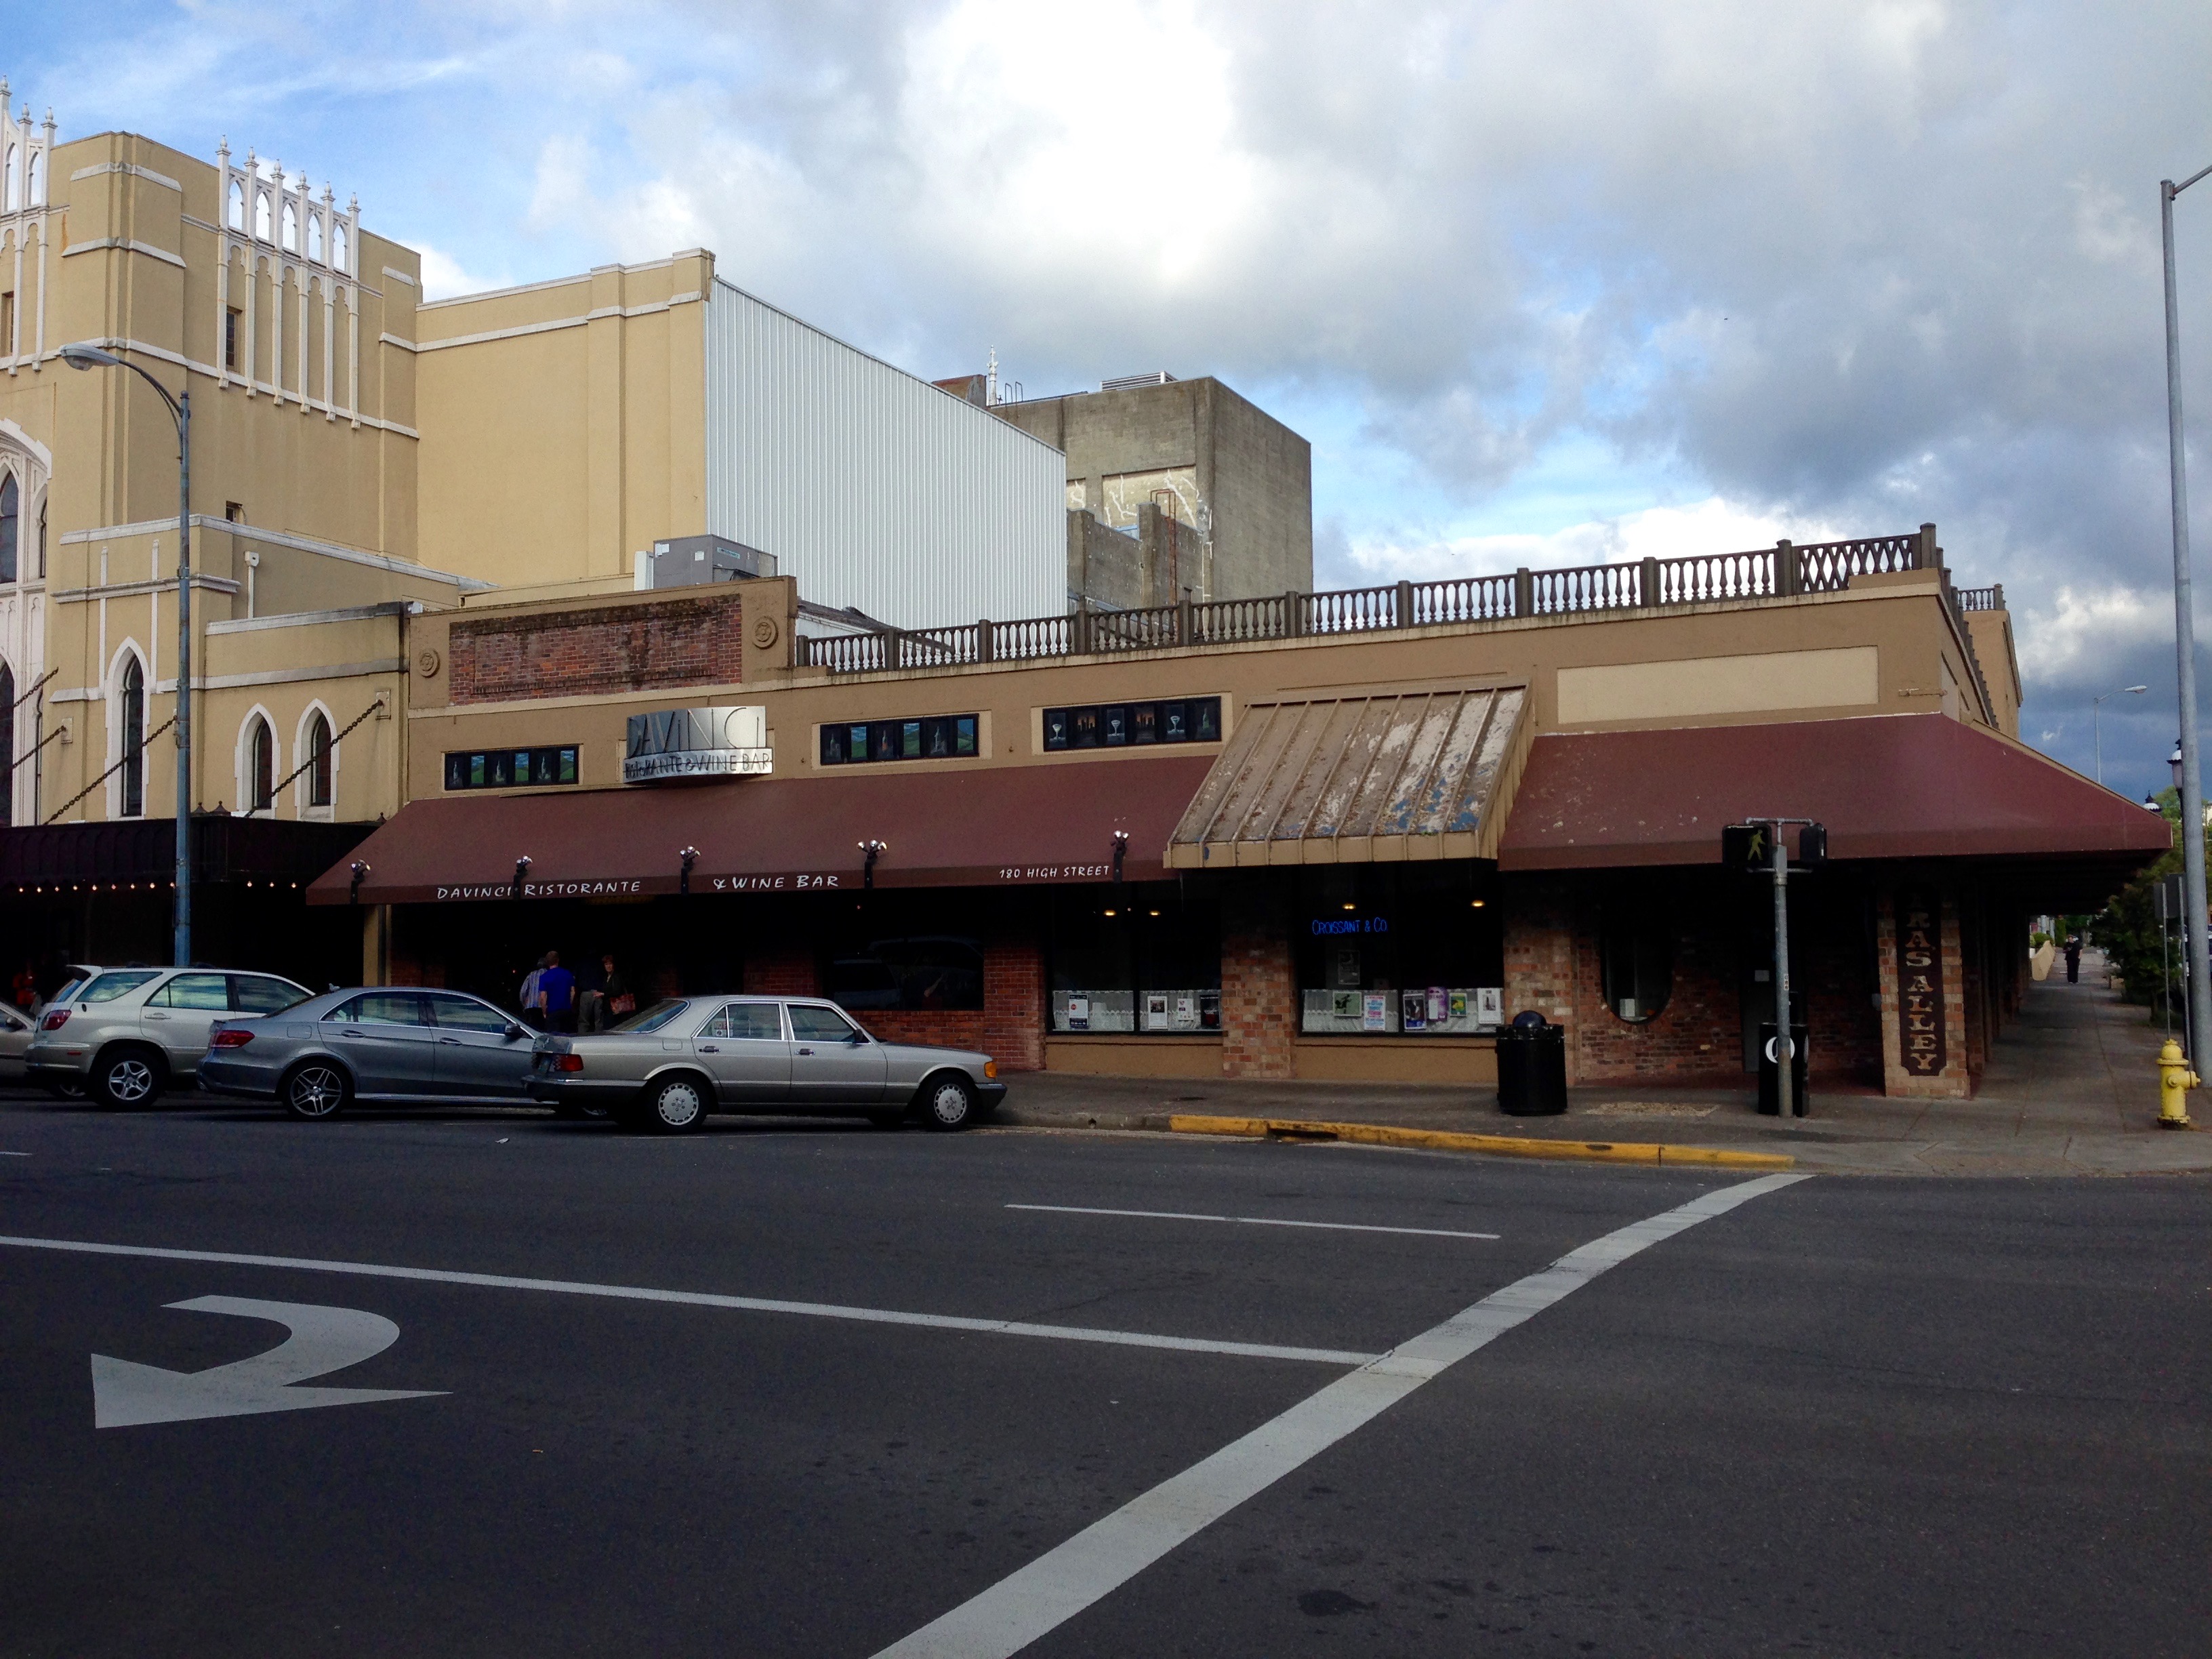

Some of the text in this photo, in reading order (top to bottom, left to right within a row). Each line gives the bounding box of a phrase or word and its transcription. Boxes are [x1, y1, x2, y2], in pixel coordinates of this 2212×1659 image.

[695, 754, 737, 771] WINE
[742, 752, 770, 771] BAR
[999, 865, 1109, 879] 180 HIGH STREET
[437, 881, 640, 899] DAVINCI RISTORANTE
[732, 876, 785, 889] WINE
[796, 875, 838, 888] BAR
[1312, 920, 1360, 935] CROISSANT
[1364, 920, 1370, 933] &
[1907, 975, 1938, 1071] ALLEY
